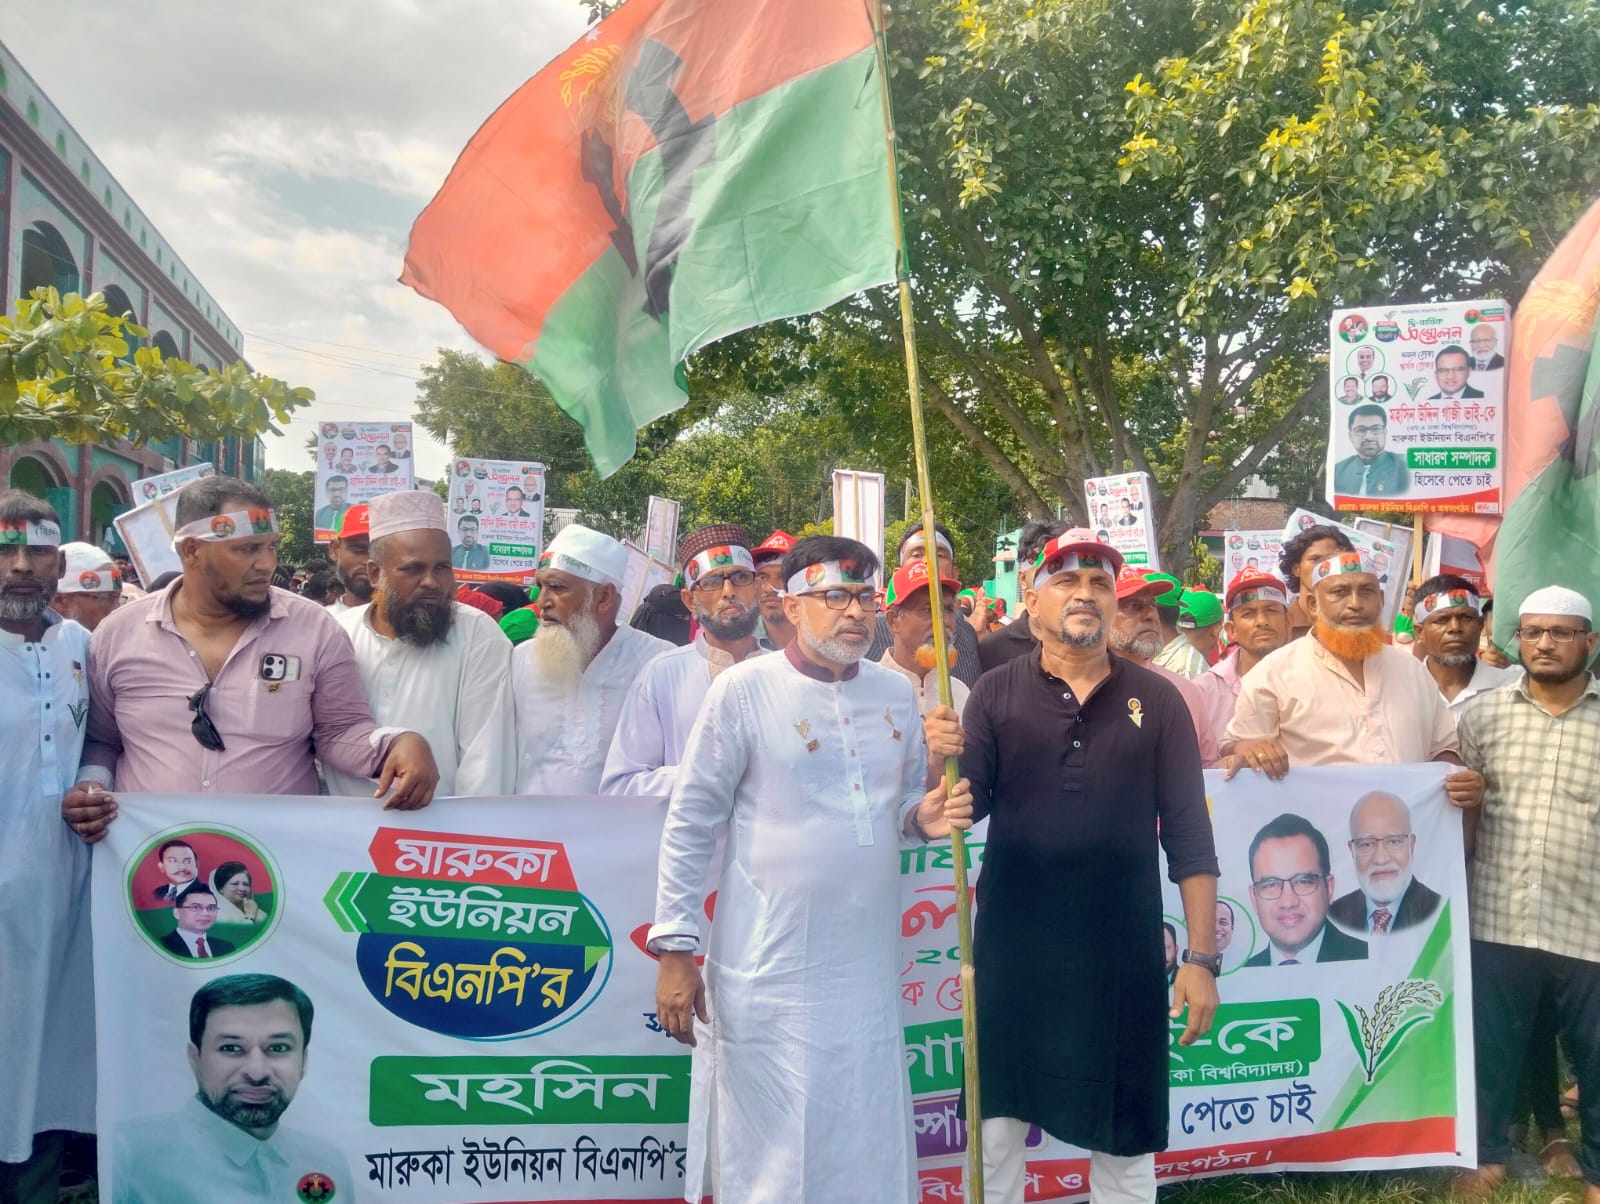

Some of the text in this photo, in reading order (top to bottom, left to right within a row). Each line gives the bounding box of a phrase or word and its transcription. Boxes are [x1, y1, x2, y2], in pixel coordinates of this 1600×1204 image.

[1413, 450, 1492, 466] সাধারণ সম্পাদক
[1414, 472, 1493, 488] হিসেবে পেতে চাই
[394, 838, 557, 882] মারুকা
[388, 885, 579, 936] ইউনিয়ন
[410, 1060, 672, 1117] মহসিন
[366, 1145, 455, 1189] মারুকা
[462, 1136, 567, 1188] ইউনিয়ন
[1181, 1097, 1260, 1135] পেতে
[1265, 1080, 1317, 1124] চাই
[1056, 1173, 1083, 1189] ও
